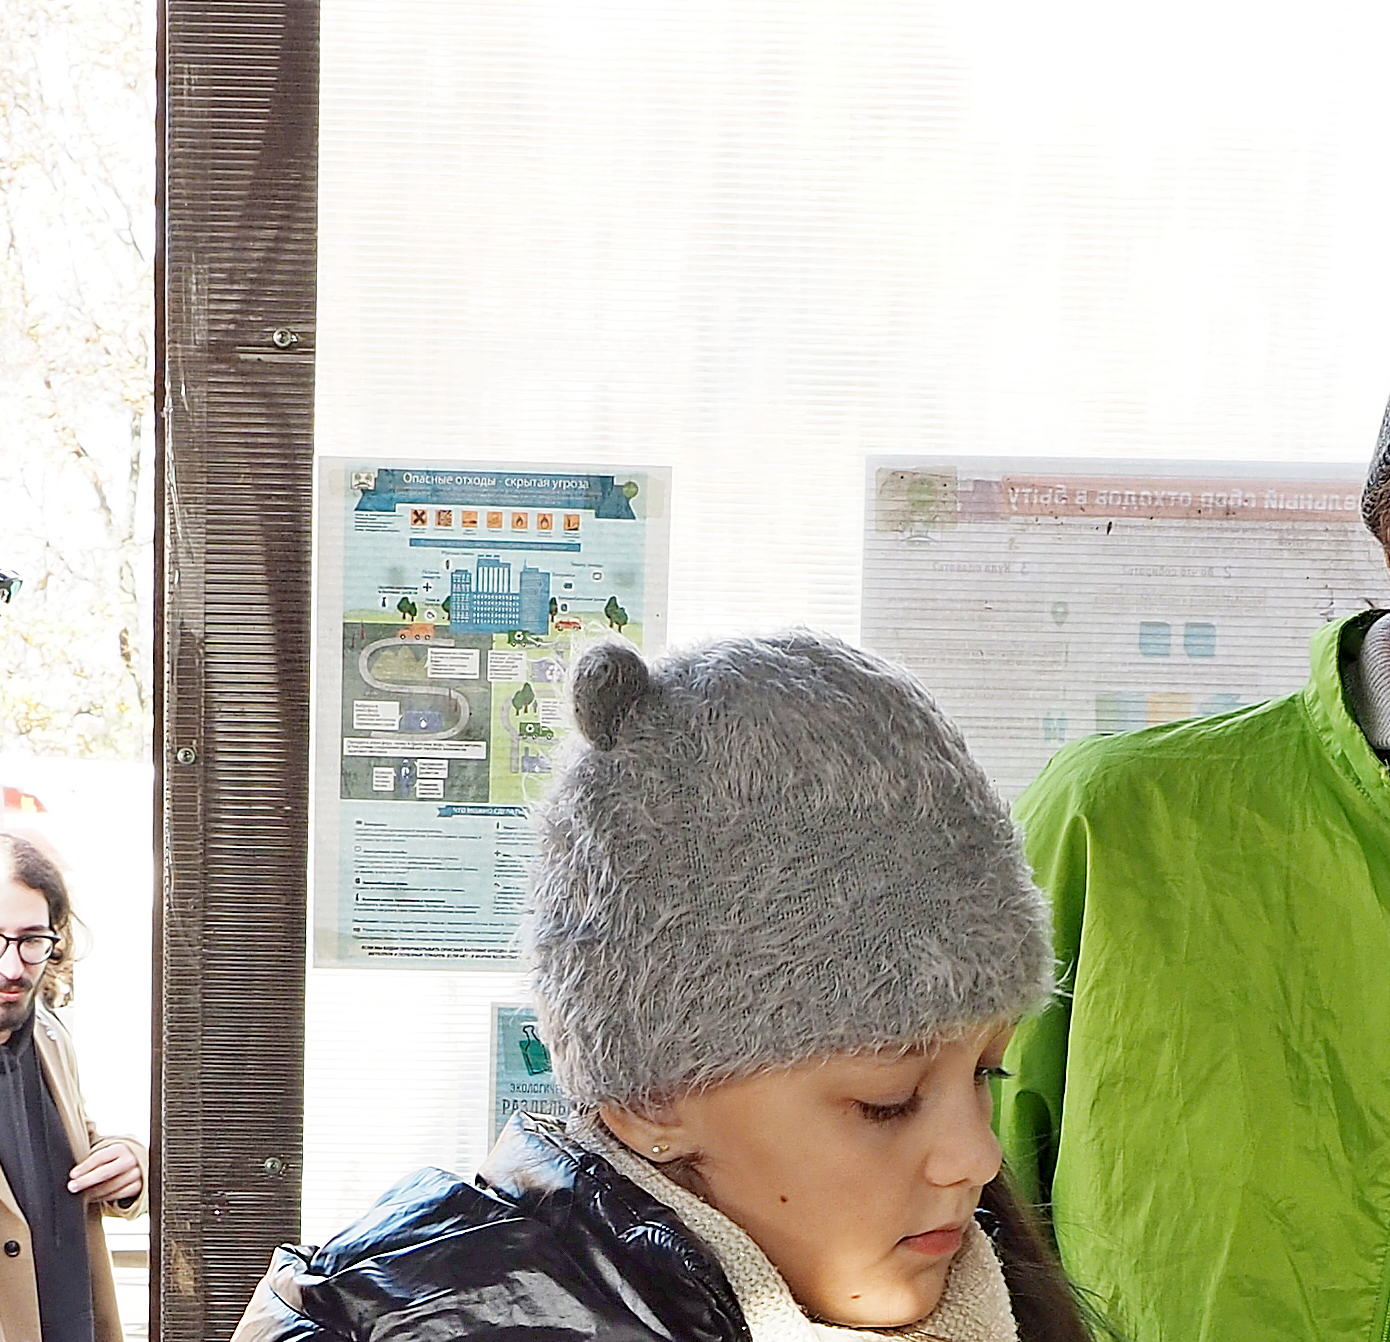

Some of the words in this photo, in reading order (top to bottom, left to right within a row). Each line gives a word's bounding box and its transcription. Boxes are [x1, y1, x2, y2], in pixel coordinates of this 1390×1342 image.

[402, 472, 453, 486] Опасные
[455, 476, 496, 487] отходы
[504, 478, 549, 490] скрытая
[552, 480, 589, 491] угроза
[502, 1099, 571, 1116] РАЗДЕЛЬ
